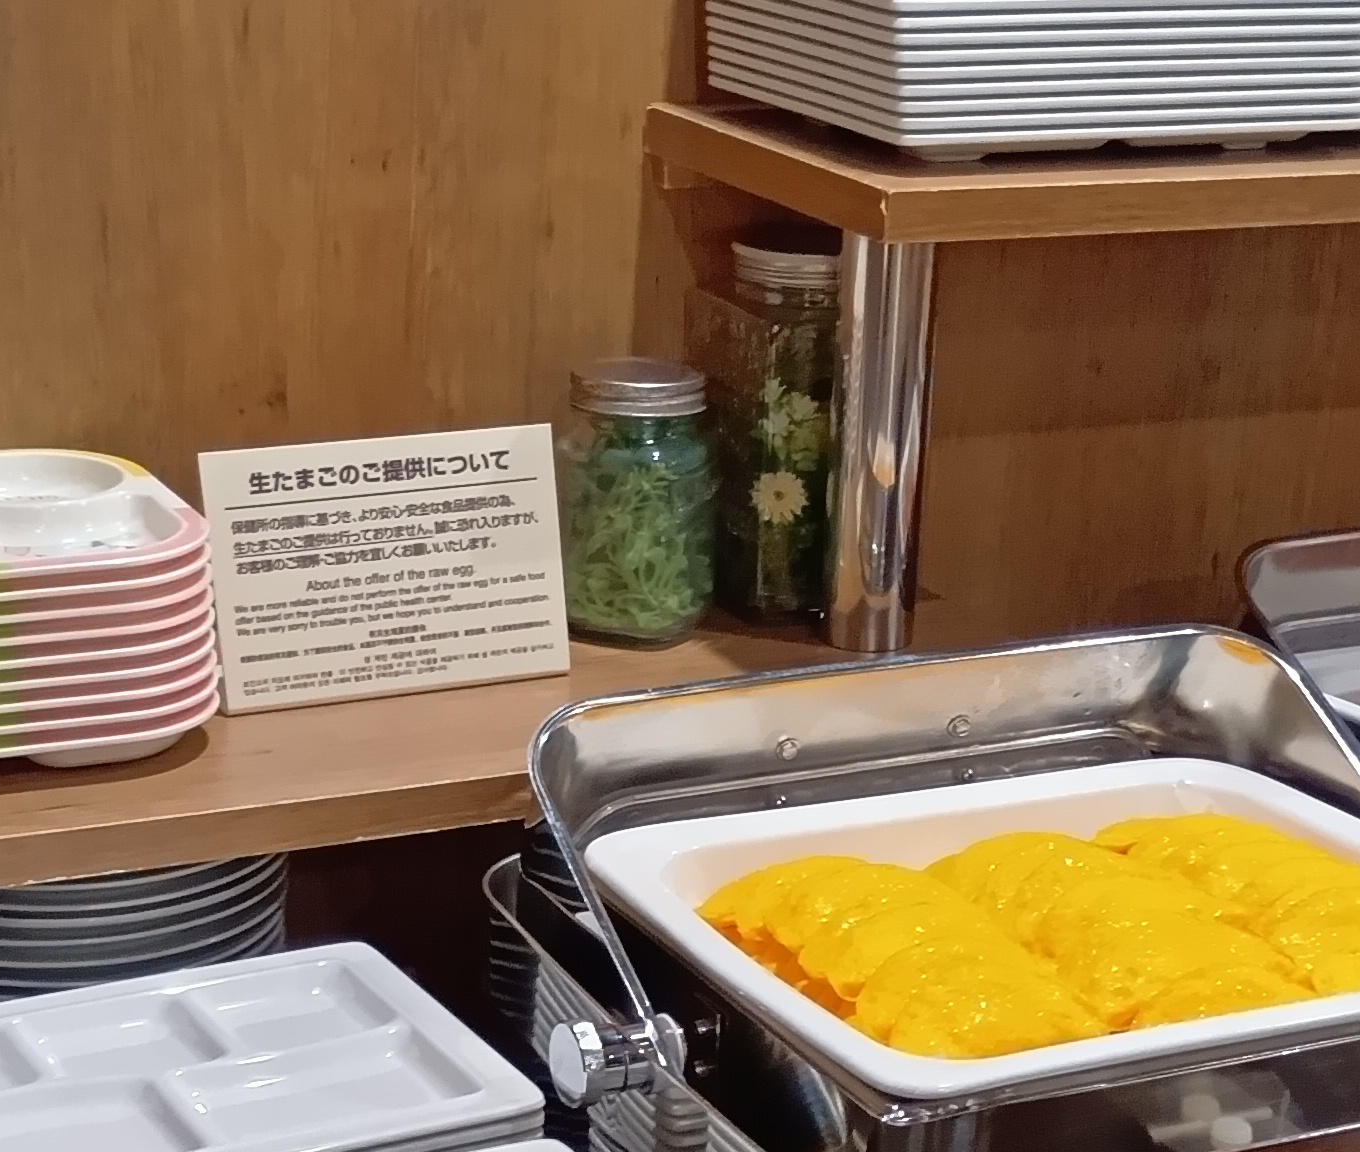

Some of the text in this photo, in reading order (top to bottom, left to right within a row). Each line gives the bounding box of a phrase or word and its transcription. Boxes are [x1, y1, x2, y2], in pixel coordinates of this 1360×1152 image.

[248, 450, 510, 495] 生たまごのご提供について
[306, 578, 341, 592] About
[343, 576, 362, 588] the
[364, 572, 390, 585] offer
[393, 570, 405, 582] of
[407, 569, 426, 581] the
[428, 568, 449, 578] raw
